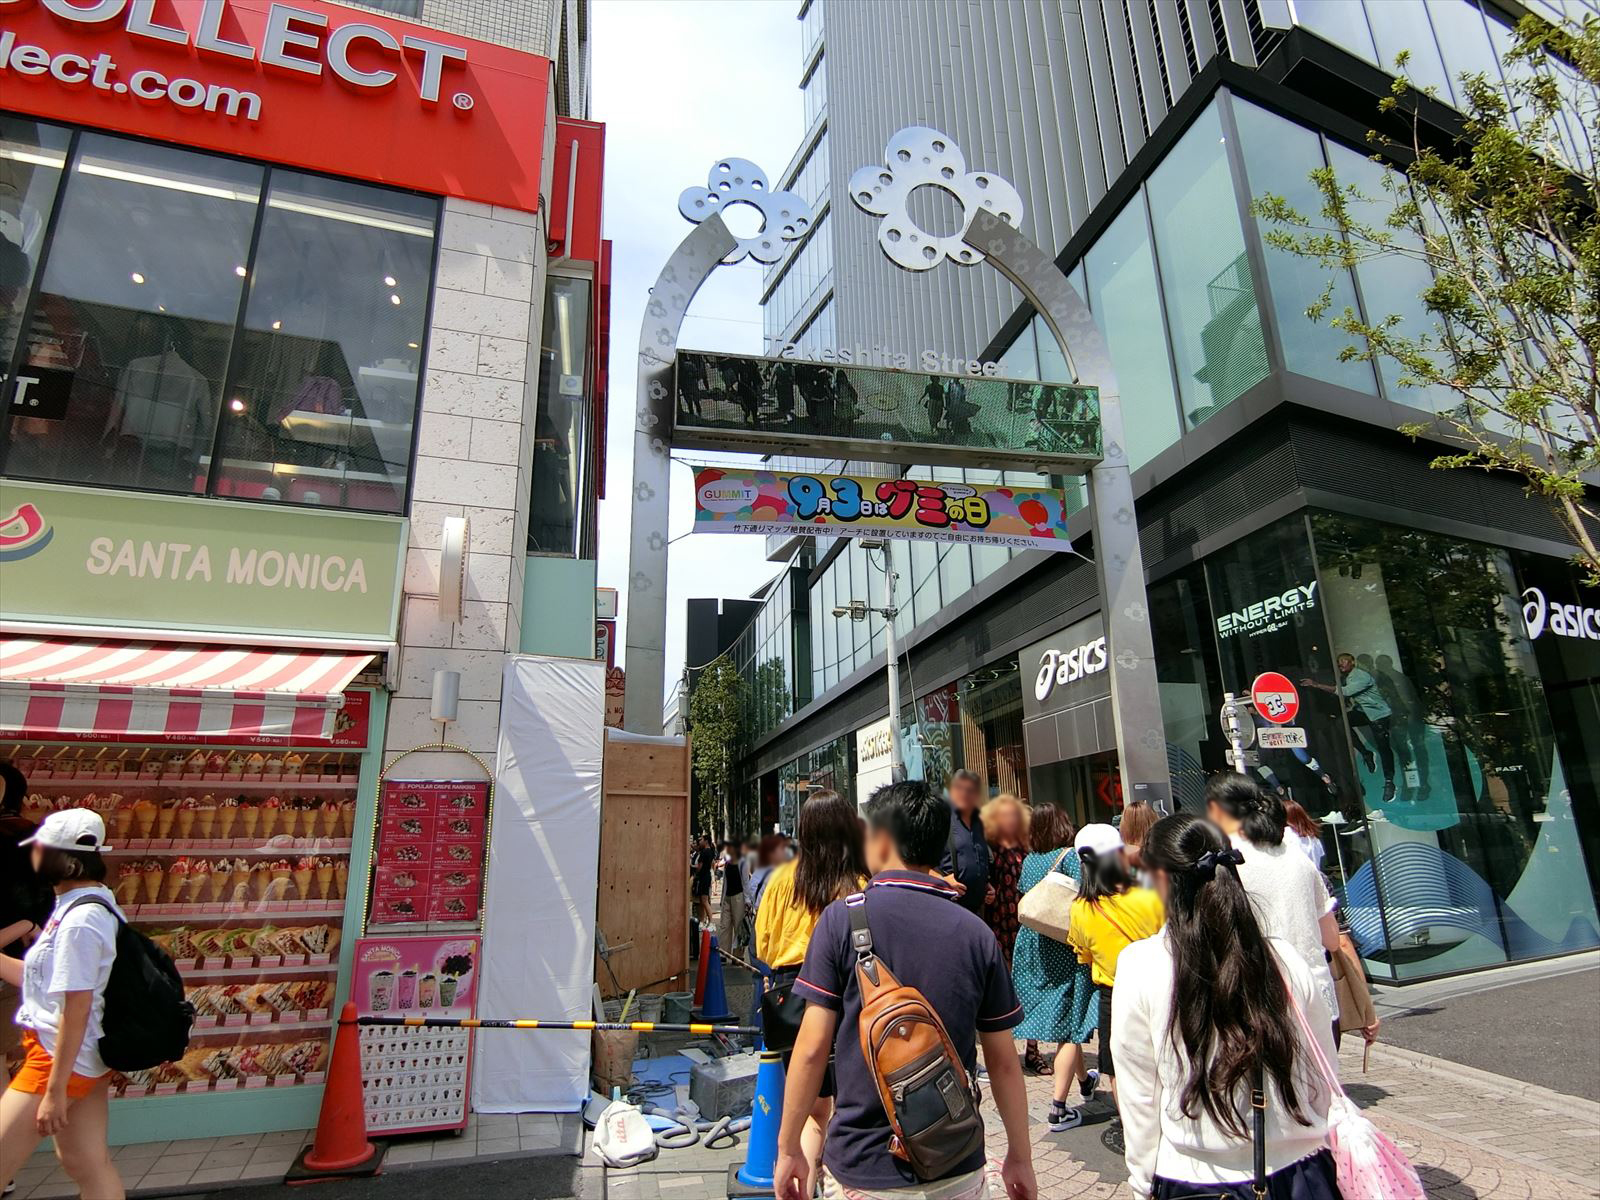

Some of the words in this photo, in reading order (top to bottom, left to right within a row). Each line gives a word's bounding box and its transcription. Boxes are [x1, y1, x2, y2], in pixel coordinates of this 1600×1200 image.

[0, 0, 468, 102] LLECT
[704, 490, 752, 499] GUMMIT
[788, 476, 991, 527] 9月3日はグミの日
[86, 536, 212, 582] SANTA
[226, 547, 367, 593] MONICA
[1217, 581, 1317, 632] ENERGY
[1219, 615, 1270, 639] WITHOUT
[1274, 599, 1315, 620] LIMITS
[1056, 636, 1107, 685] asics
